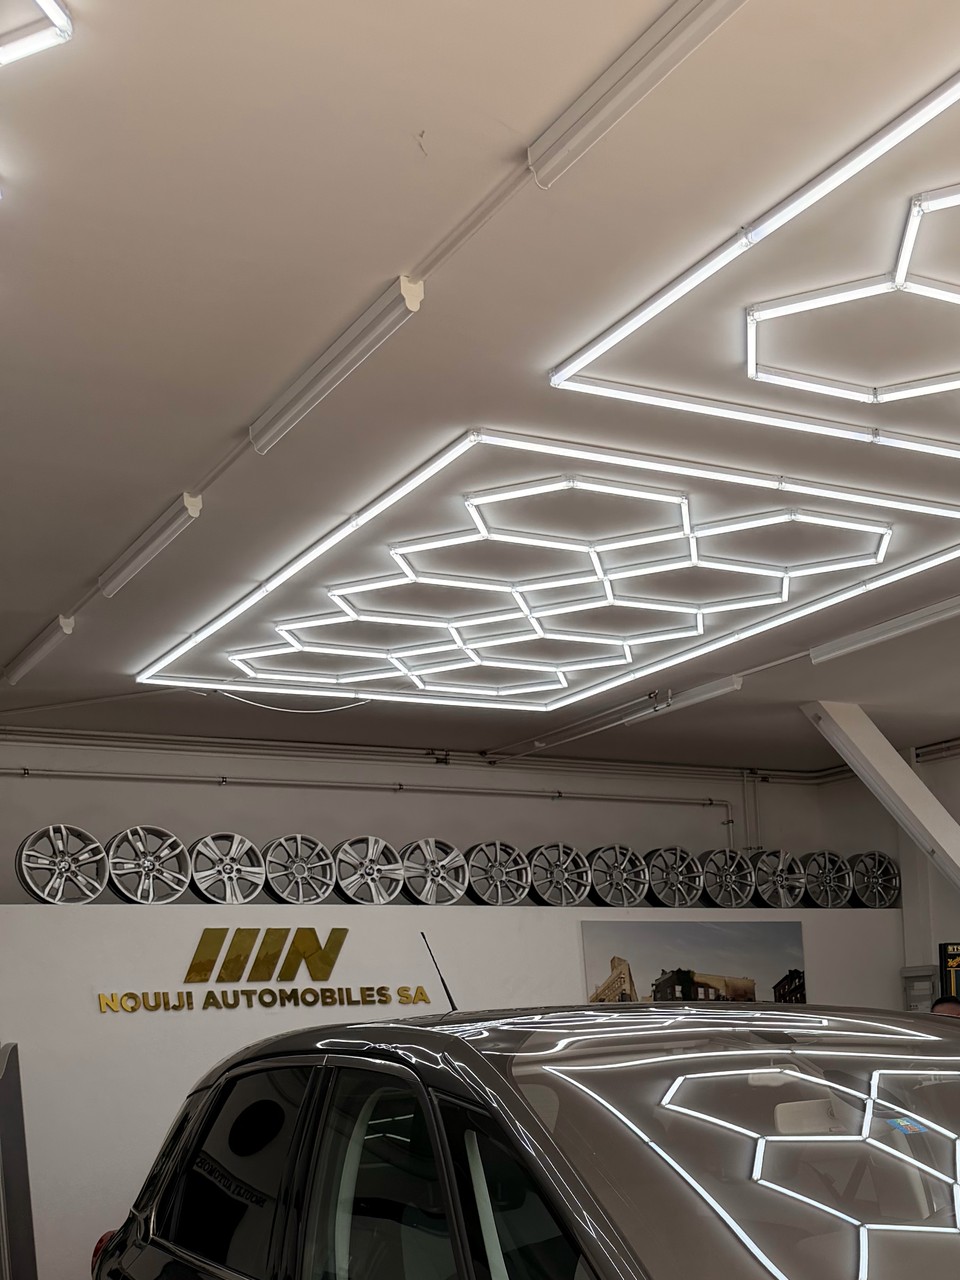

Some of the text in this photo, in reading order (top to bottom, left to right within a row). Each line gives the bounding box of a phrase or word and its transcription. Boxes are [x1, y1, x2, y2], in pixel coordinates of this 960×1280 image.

[98, 985, 431, 1013] NOUIJI AUTOMOBILES SA
